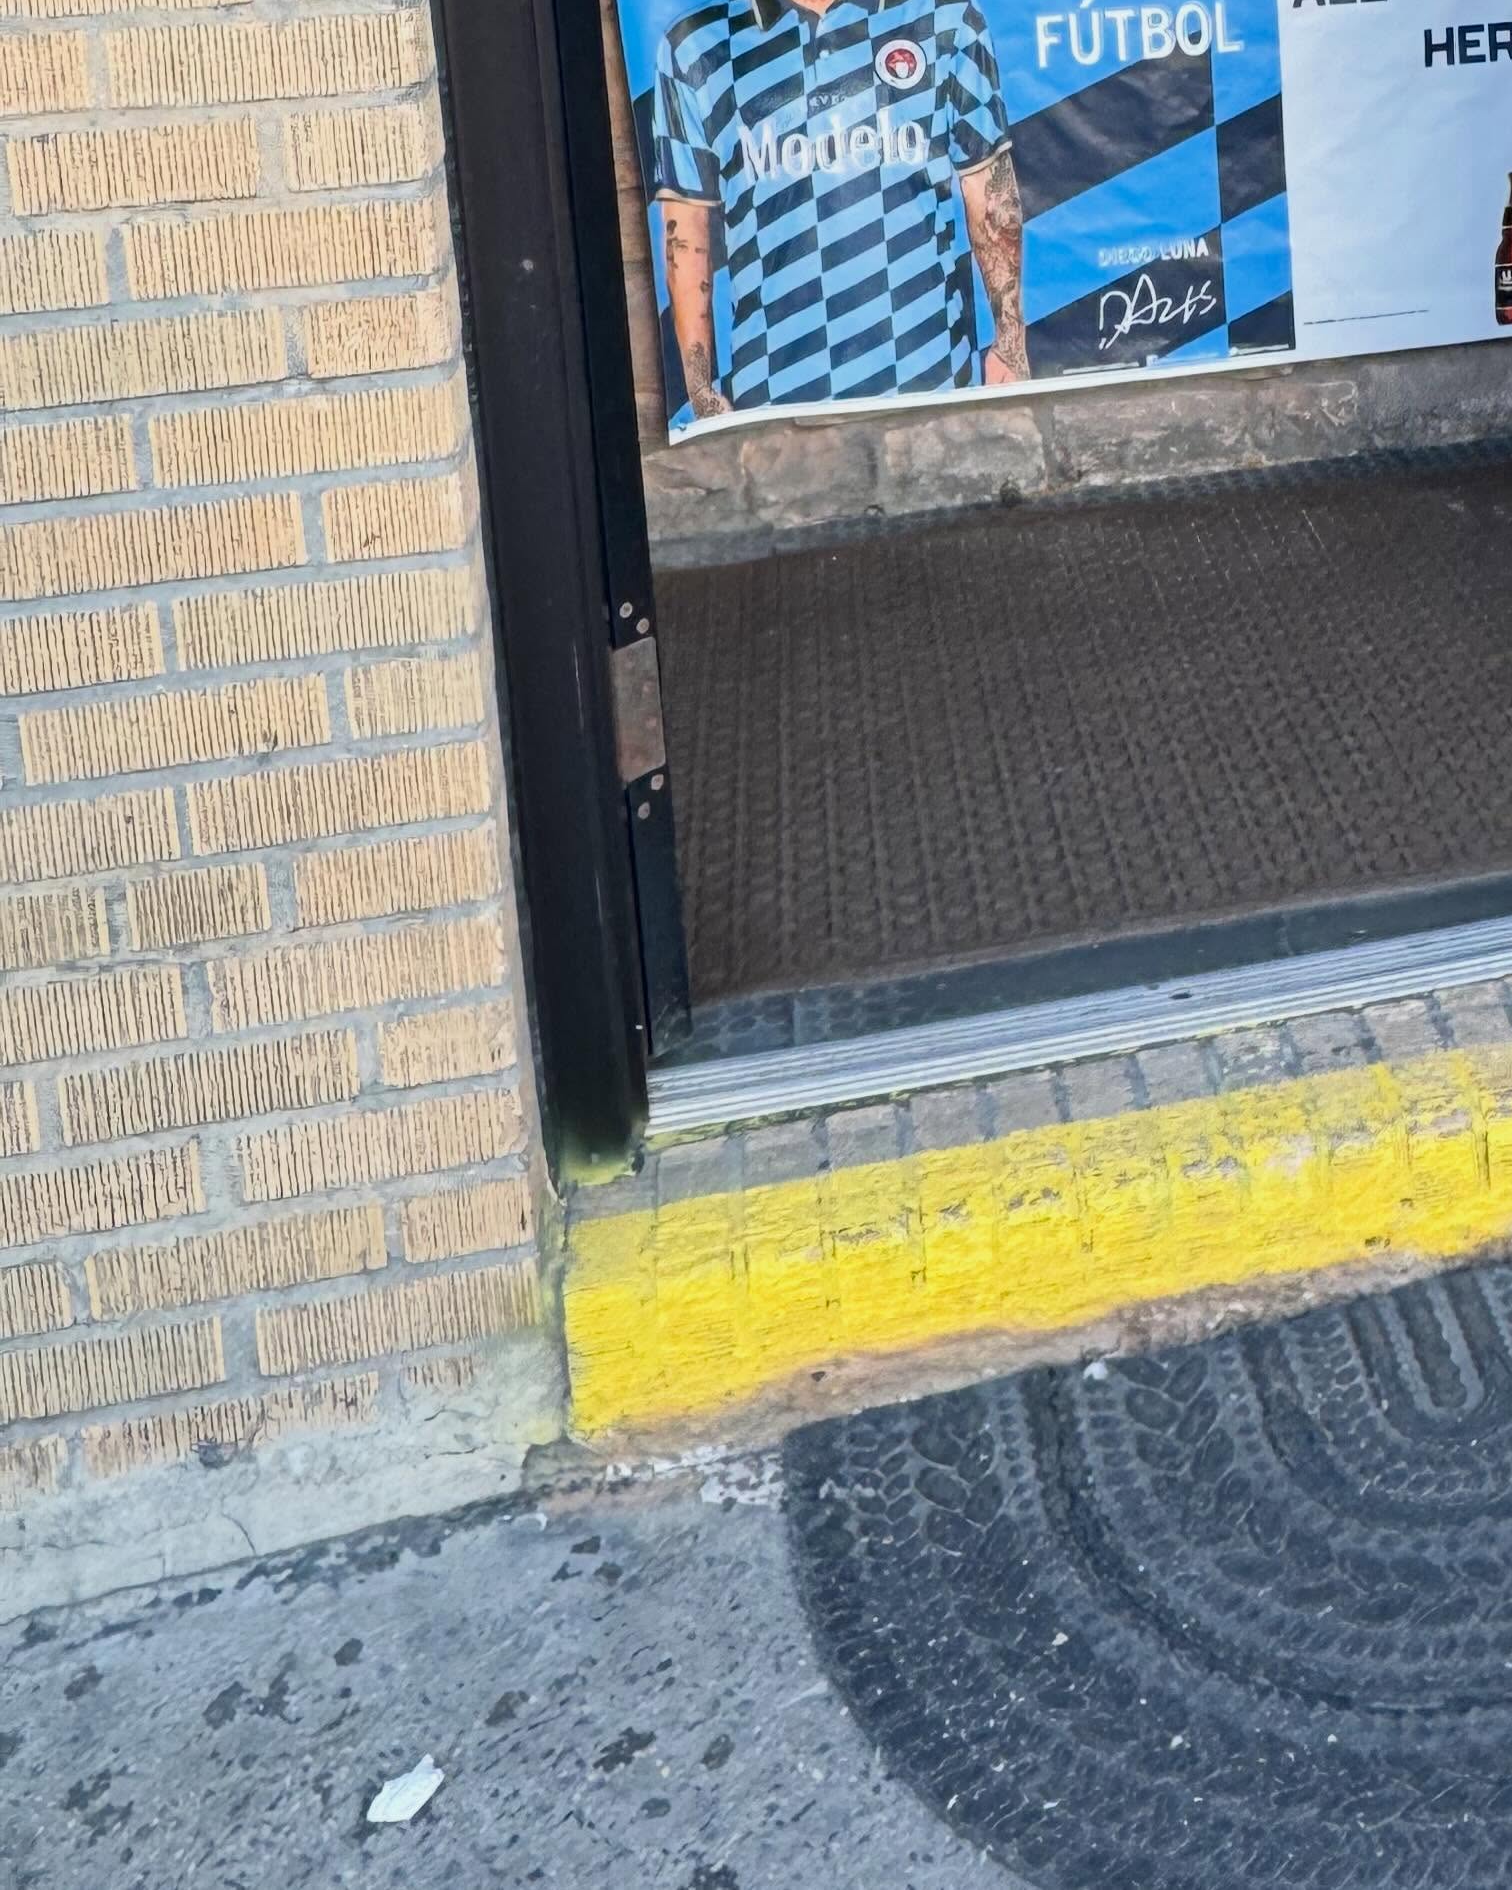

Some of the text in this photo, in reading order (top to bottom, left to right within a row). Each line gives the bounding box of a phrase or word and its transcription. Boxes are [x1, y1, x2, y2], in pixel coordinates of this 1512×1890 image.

[736, 108, 931, 186] Modelo
[1098, 237, 1210, 267] DIEGO LUNA
